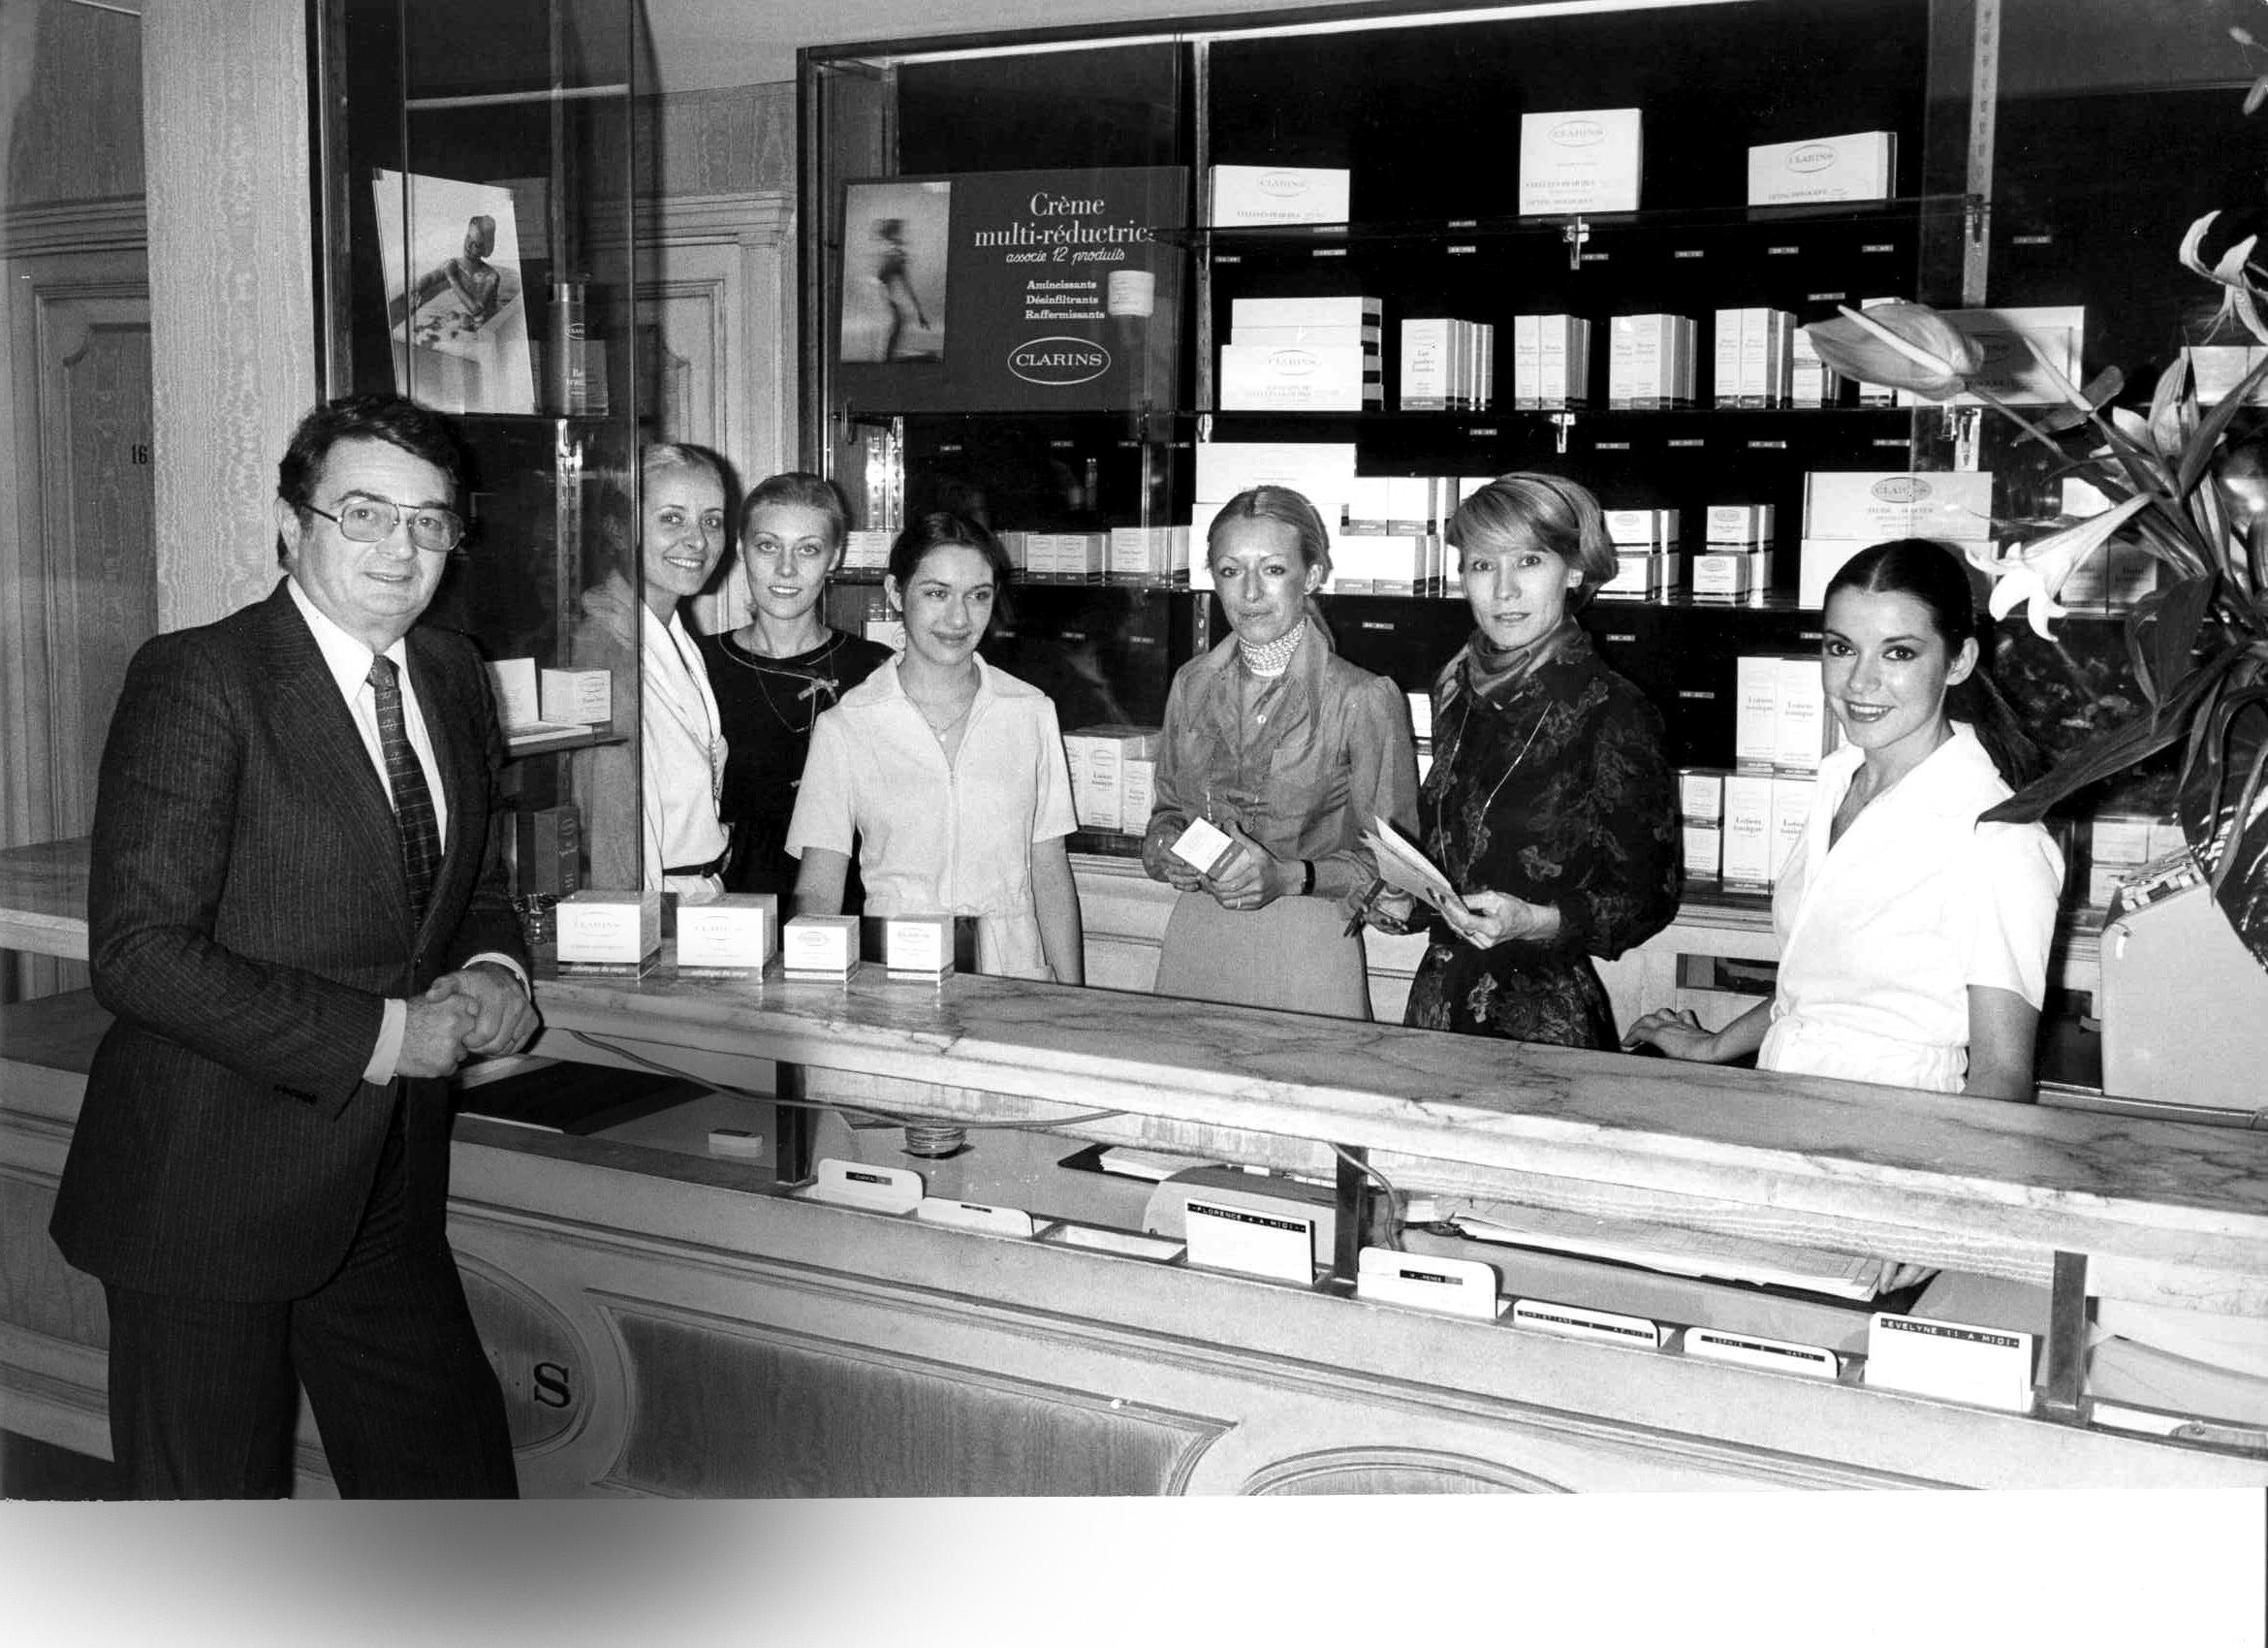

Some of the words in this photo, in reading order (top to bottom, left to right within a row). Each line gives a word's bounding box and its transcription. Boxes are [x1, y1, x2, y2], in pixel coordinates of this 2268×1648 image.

[1029, 192, 1105, 216] Crème
[1005, 250, 1048, 264] associe
[1053, 246, 1069, 263] 12
[1071, 248, 1125, 267] produits
[1026, 280, 1097, 290] Amincissants
[1025, 295, 1099, 304] Désinfiltrants
[1025, 309, 1106, 319] Raffermissants
[1016, 354, 1103, 366] CLARINS
[131, 444, 148, 465] 16
[534, 1362, 572, 1409] S
